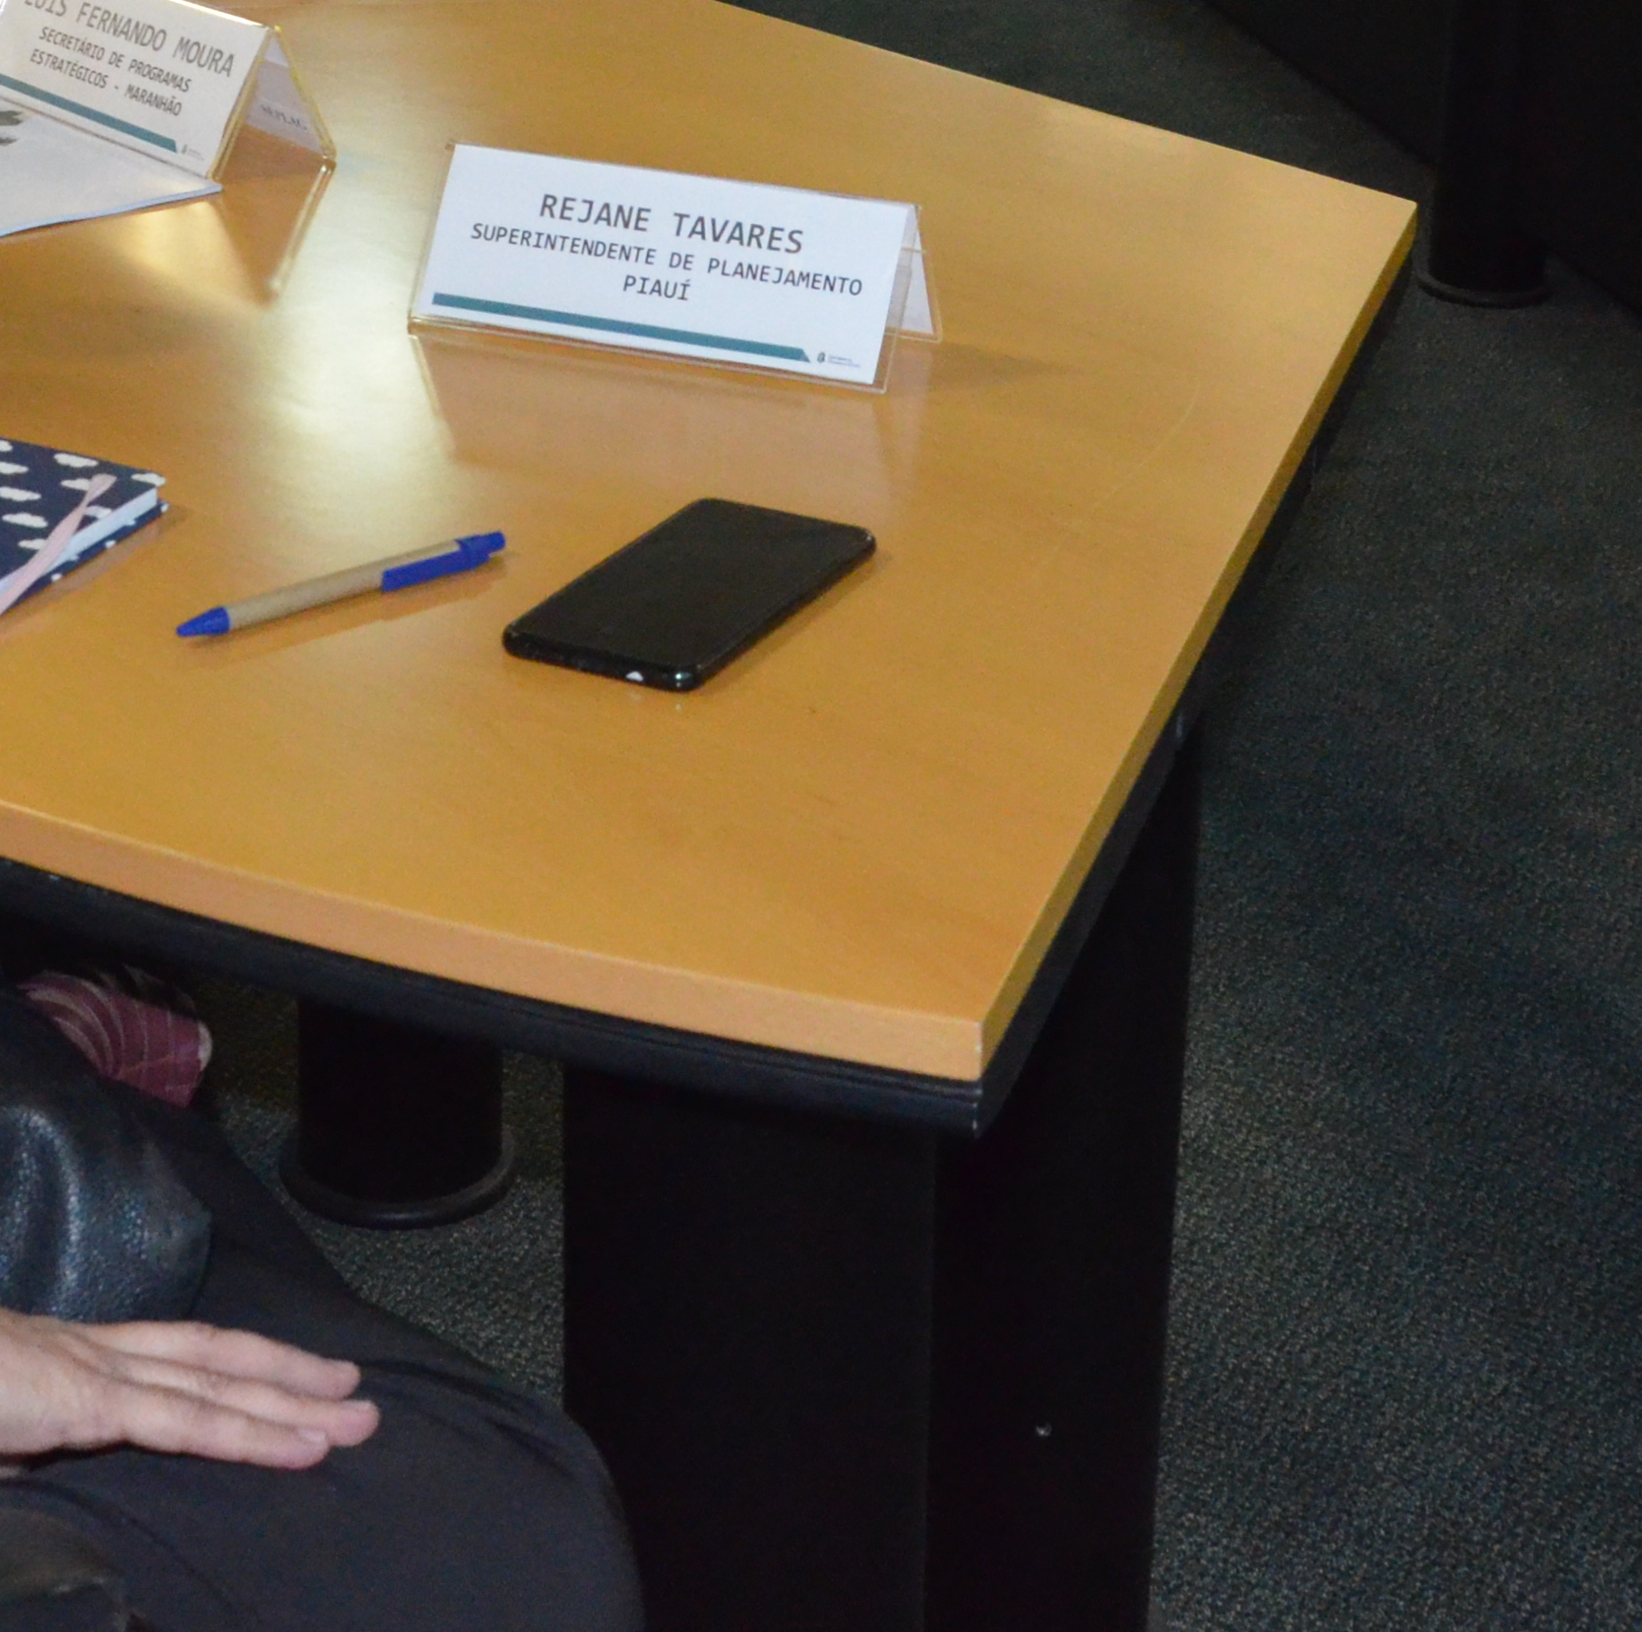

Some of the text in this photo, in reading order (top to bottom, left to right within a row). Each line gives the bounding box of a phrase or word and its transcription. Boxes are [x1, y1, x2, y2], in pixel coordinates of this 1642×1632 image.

[39, 25, 192, 93] SECRETÁRIO DE PROGRAMAS
[75, 3, 168, 52] FERNANDO
[173, 35, 235, 78] MOURA
[30, 48, 109, 90] ESTRATÉGICOS
[124, 83, 182, 118] MARANHÃO
[538, 193, 804, 254] REJANE TAVARES
[470, 222, 864, 297] SUPERINTENDENTE DE PLANEJAMENTO
[623, 274, 692, 302] PIAUÍ
